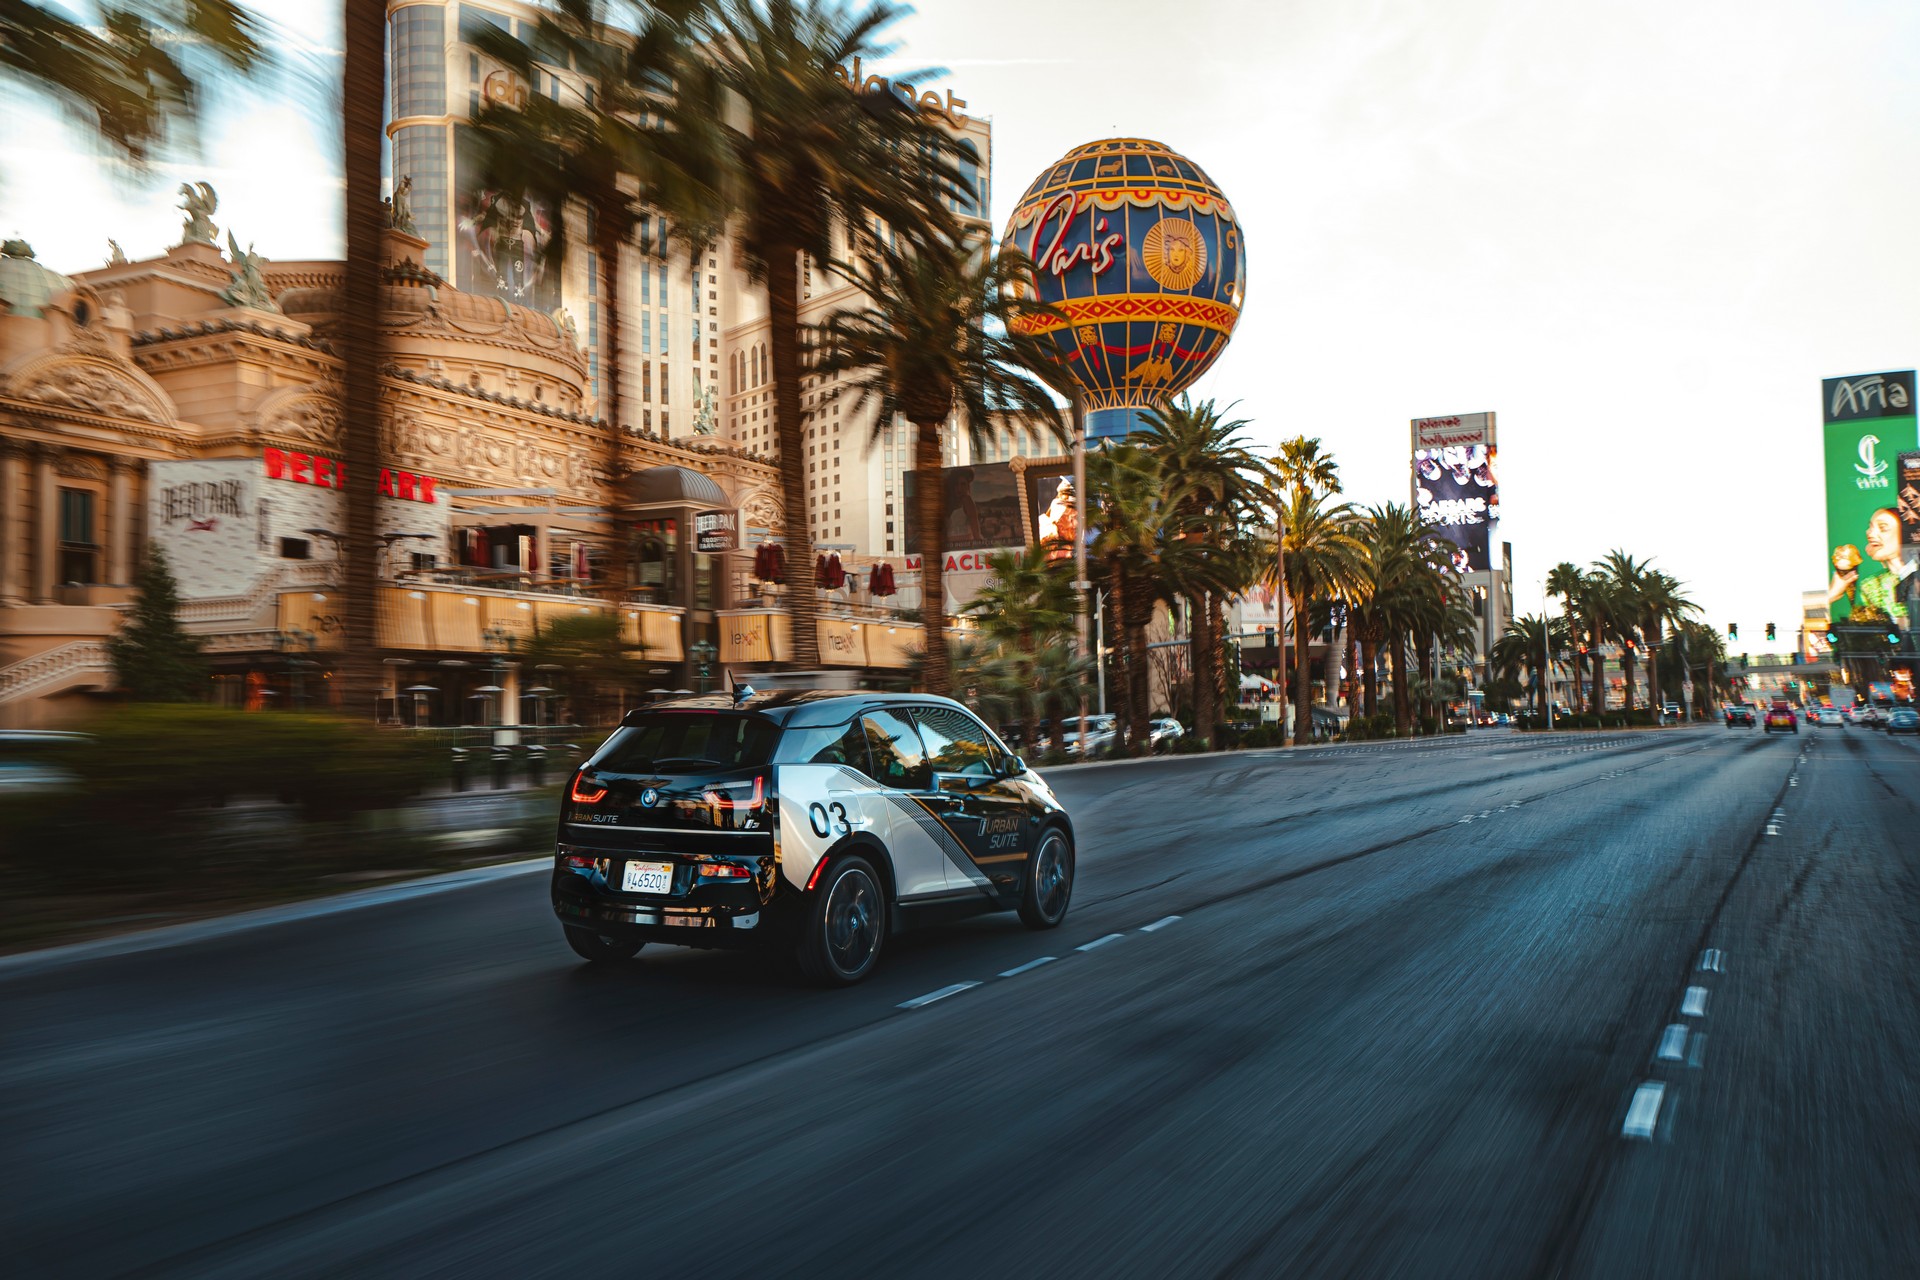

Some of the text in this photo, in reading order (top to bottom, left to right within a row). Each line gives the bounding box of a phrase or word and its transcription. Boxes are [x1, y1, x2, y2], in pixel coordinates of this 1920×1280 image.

[1028, 189, 1123, 292] Paris
[1830, 375, 1909, 417] Aria
[1419, 415, 1461, 433] planet
[1420, 429, 1483, 447] hollywood
[376, 467, 437, 504] ARK
[906, 551, 996, 572] MACLE
[571, 813, 619, 823] RBAN SUITE
[809, 801, 852, 839] 03
[986, 817, 1019, 833] URBAN
[989, 832, 1020, 848] SUITE
[632, 872, 662, 889] 46520
